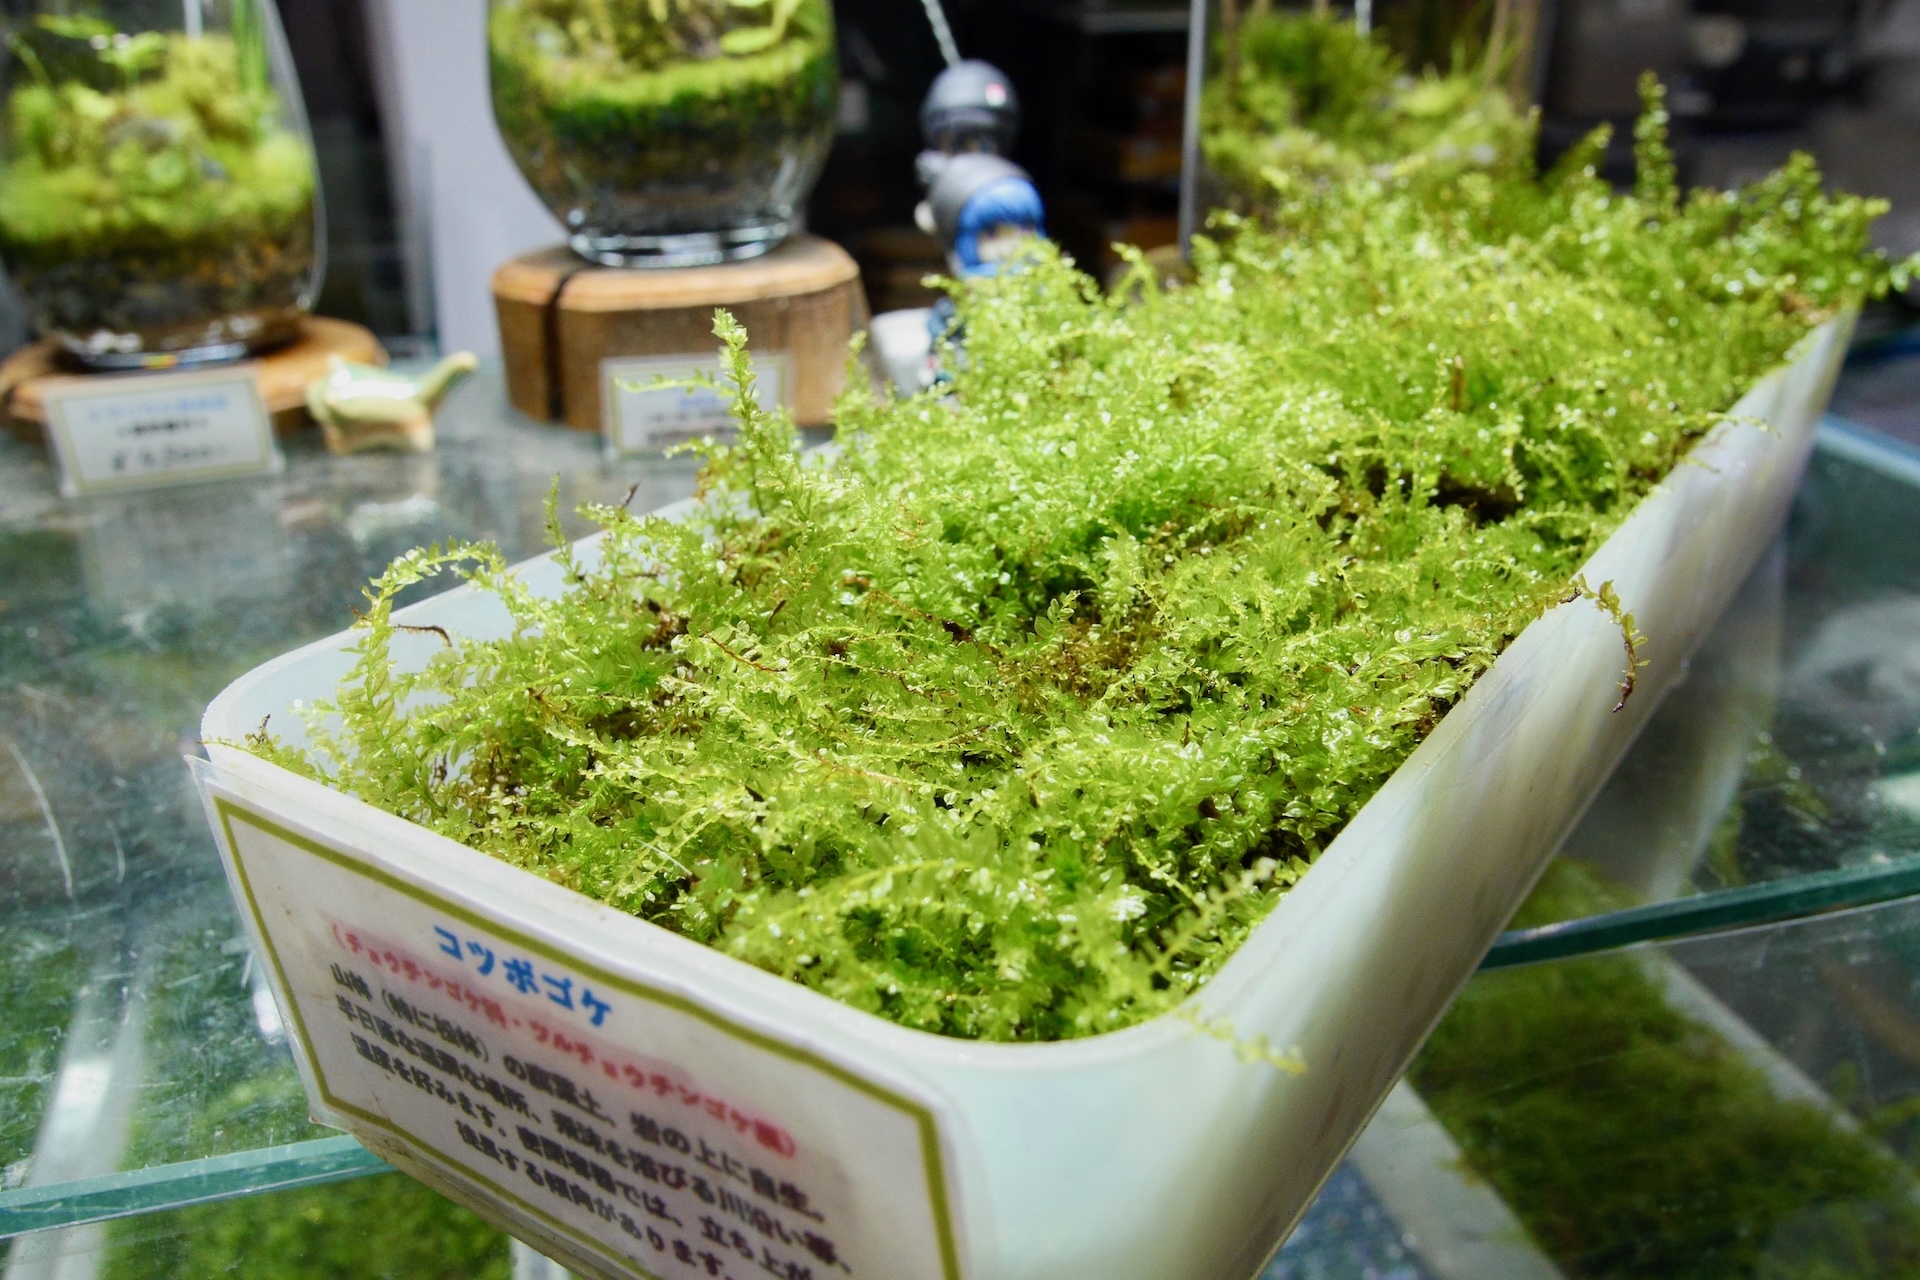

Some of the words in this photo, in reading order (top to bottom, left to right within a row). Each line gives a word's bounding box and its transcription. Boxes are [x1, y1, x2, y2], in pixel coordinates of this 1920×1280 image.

[434, 925, 612, 1026] コツボゴケ
